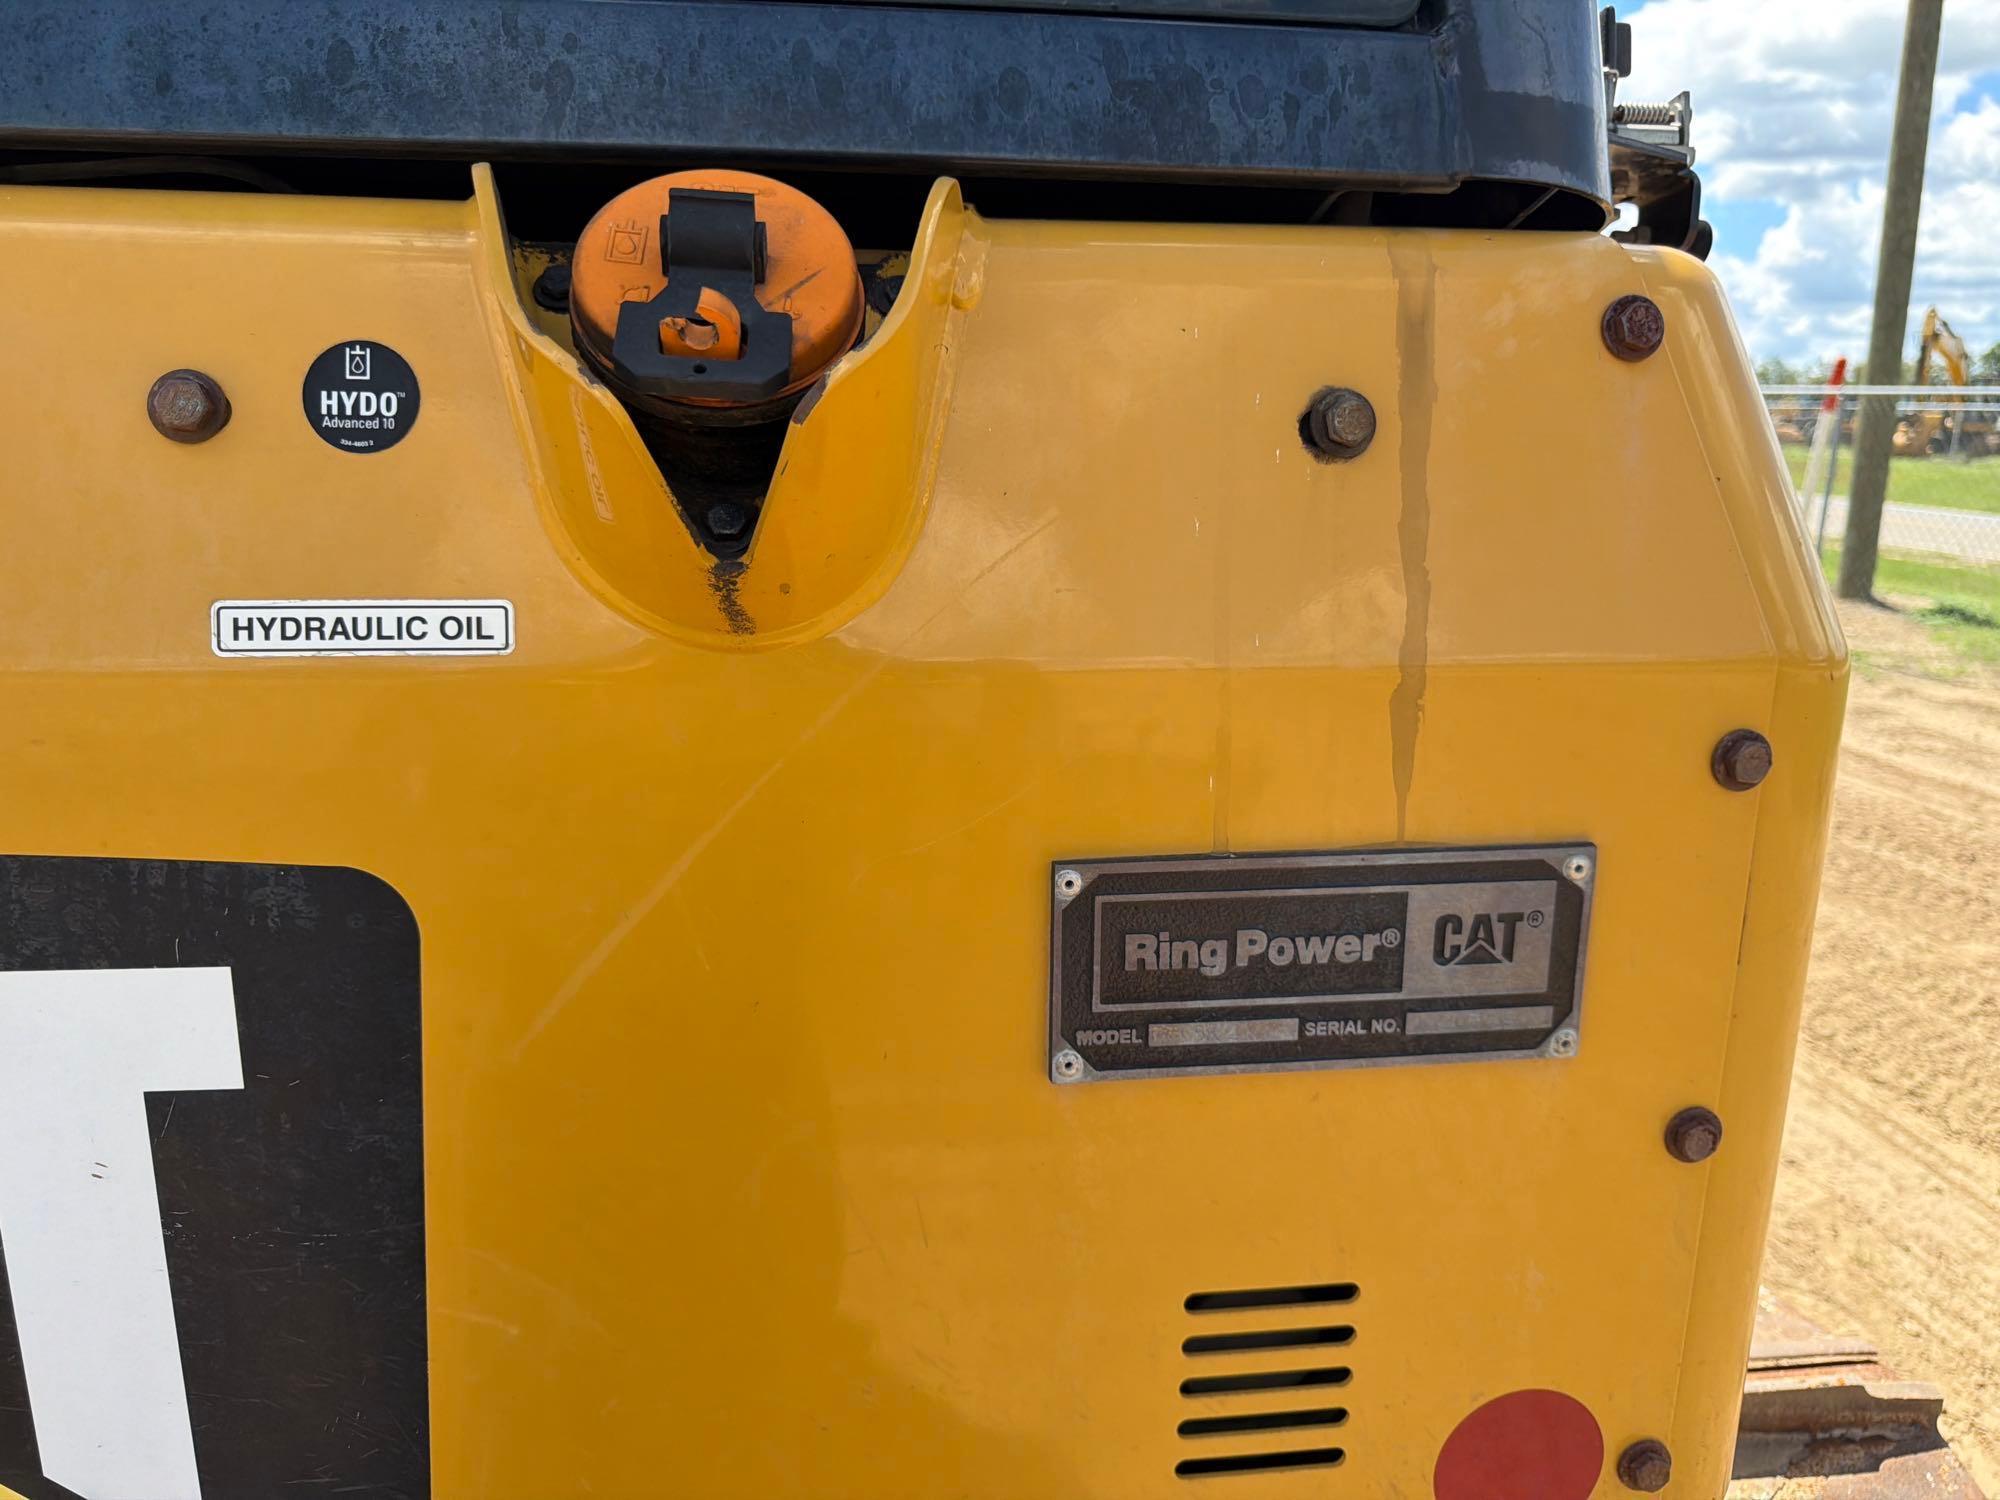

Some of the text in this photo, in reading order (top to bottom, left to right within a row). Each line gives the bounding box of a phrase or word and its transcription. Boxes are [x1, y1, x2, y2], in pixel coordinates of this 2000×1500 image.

[322, 416, 395, 429] Advanced 10
[233, 616, 494, 641] HYDRAULIC OIL
[1124, 931, 1228, 976] Ring
[1305, 1019, 1367, 1037] SERIAL
[1372, 1018, 1400, 1034] NO.
[1076, 1029, 1143, 1046] MODEL
